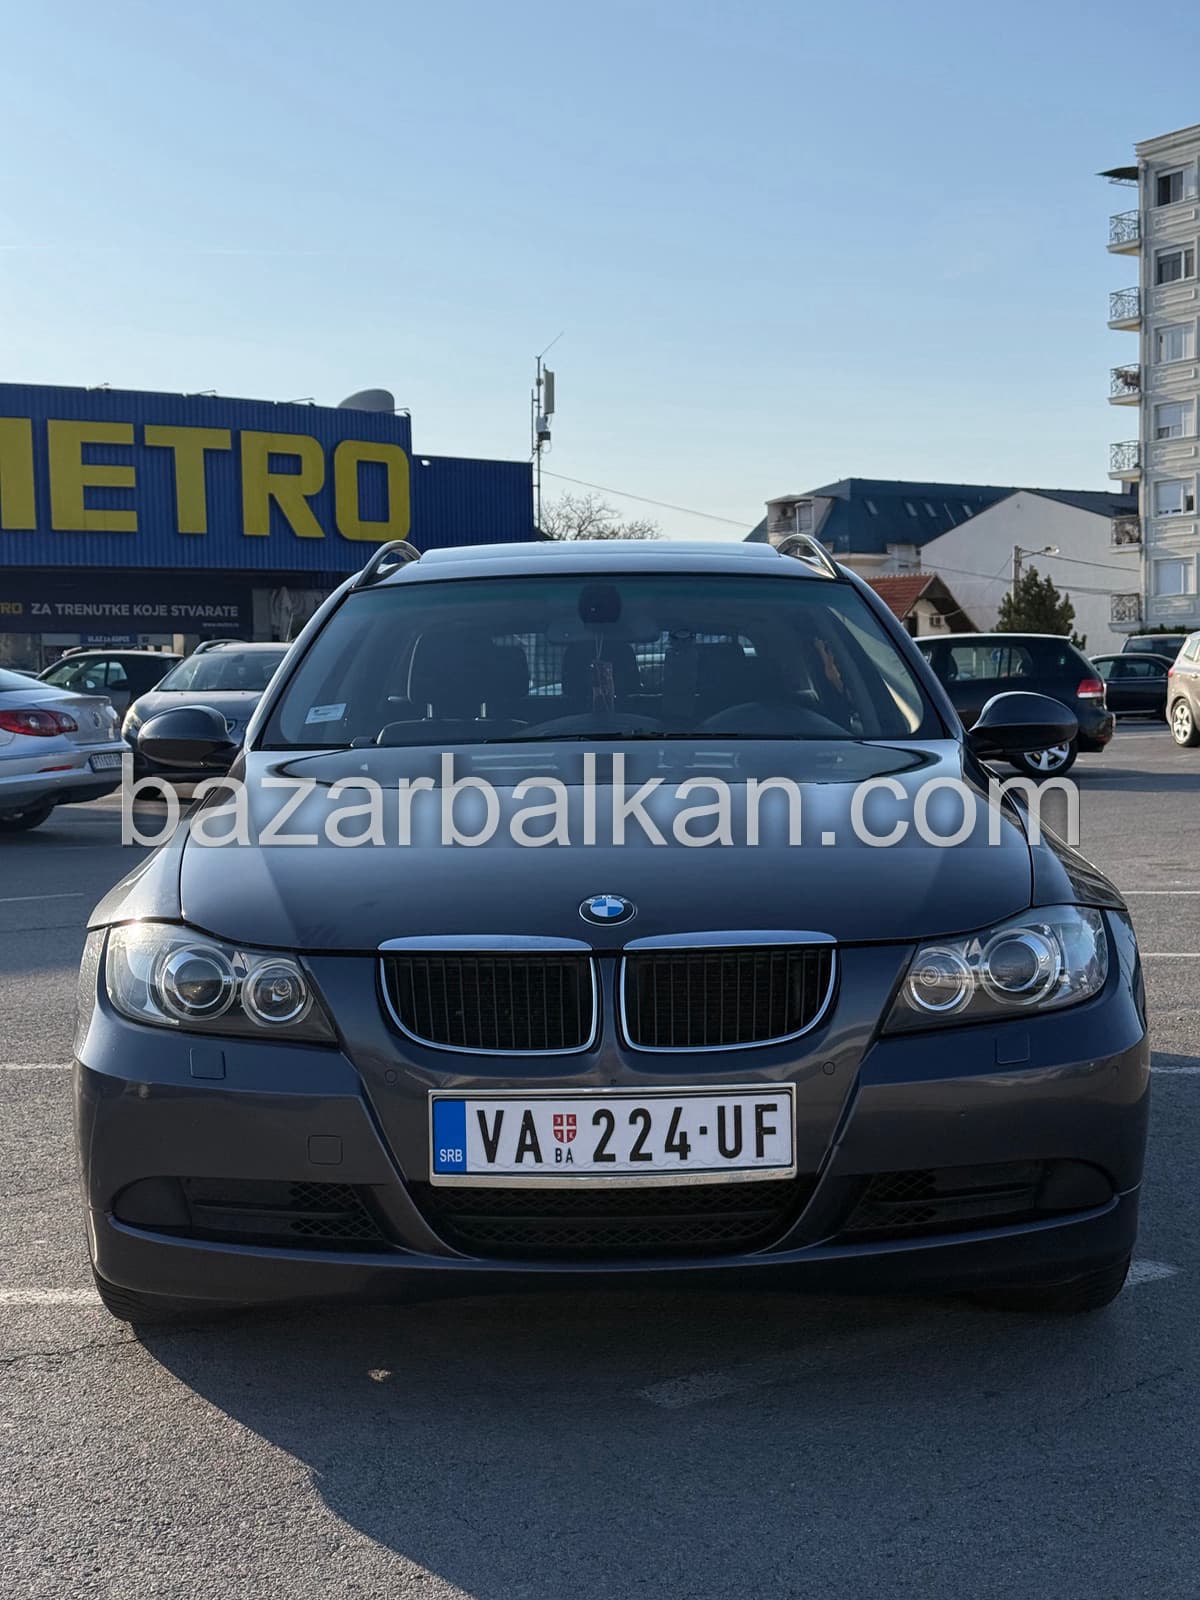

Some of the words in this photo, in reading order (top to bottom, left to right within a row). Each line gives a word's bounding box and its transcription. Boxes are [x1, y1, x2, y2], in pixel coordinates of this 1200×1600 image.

[0, 602, 22, 615] RO
[31, 603, 52, 616] ZA
[55, 603, 130, 616] TRENUTKE
[133, 604, 168, 616] KOJE
[171, 605, 239, 617] STVARATE
[476, 1109, 543, 1164] VA
[439, 1149, 463, 1163] SRB
